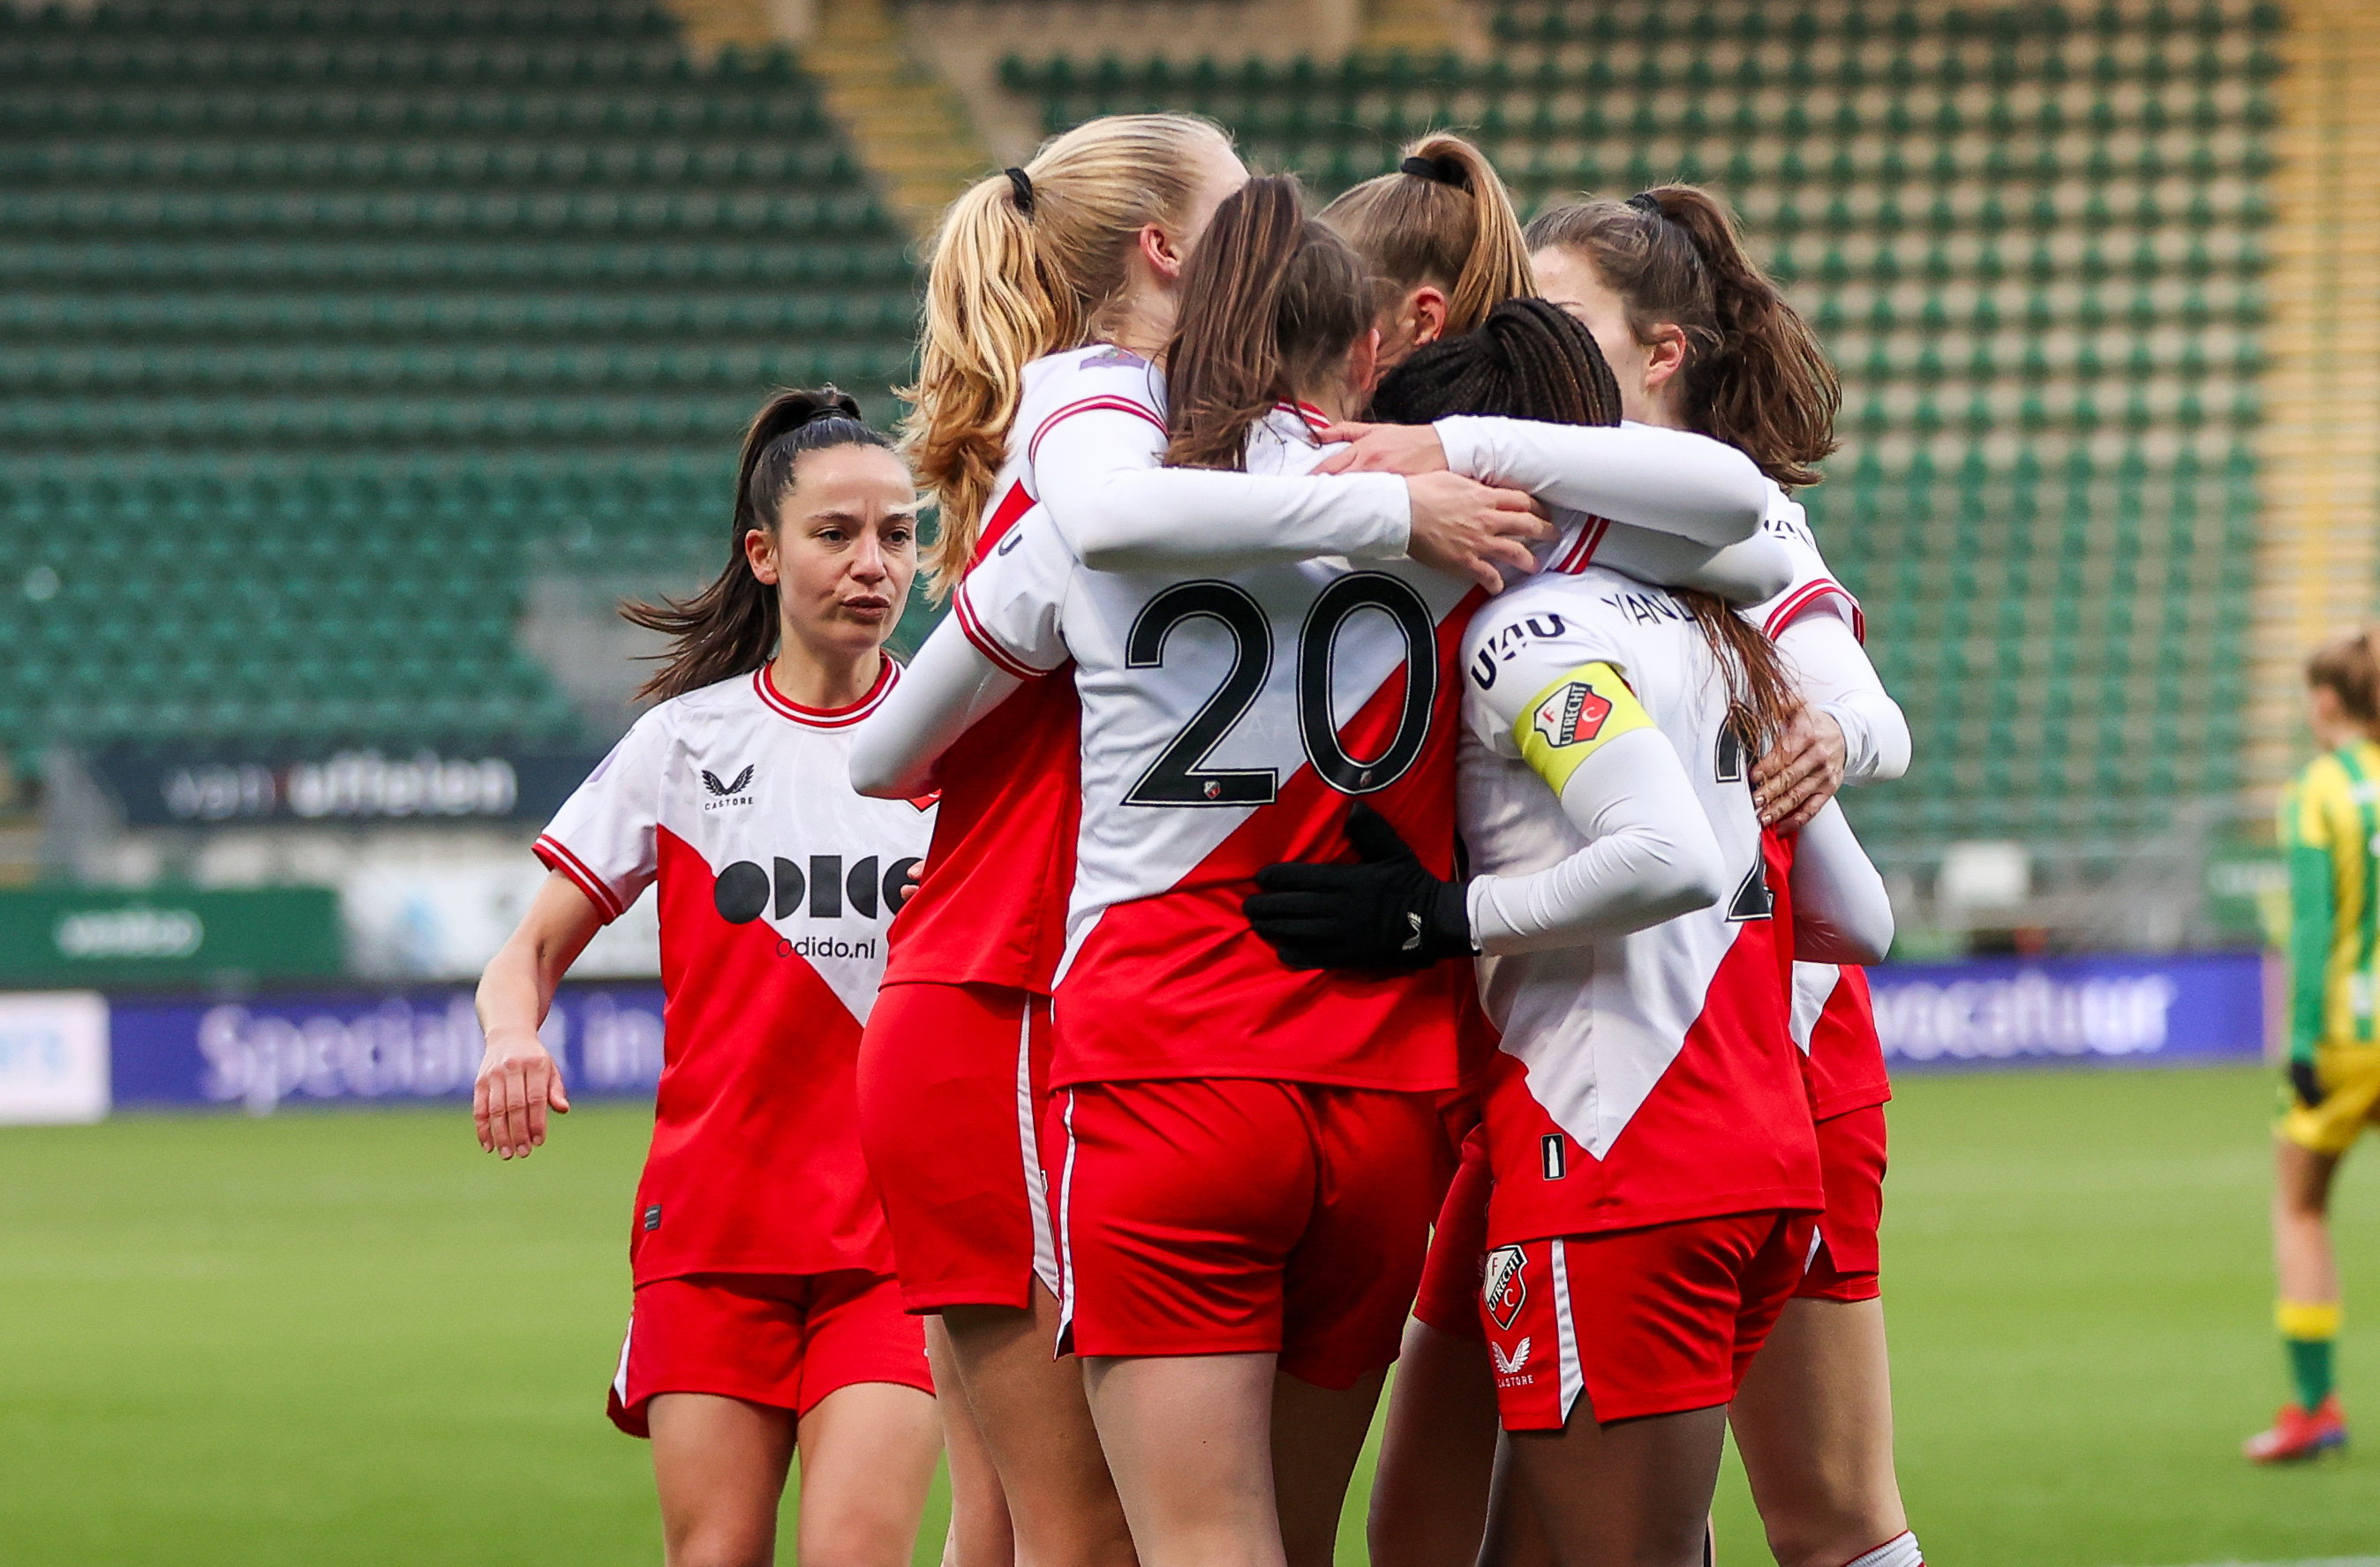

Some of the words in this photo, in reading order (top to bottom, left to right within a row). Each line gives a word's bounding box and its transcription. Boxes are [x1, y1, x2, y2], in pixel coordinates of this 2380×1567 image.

[1120, 571, 1438, 806] 20
[1541, 705, 1555, 723] F
[1560, 684, 1587, 745] UTRECHT
[1581, 706, 1604, 723] C
[704, 796, 754, 810] CASTORE
[777, 936, 876, 960] Odido.nl
[1488, 1252, 1520, 1312] UTRECHT
